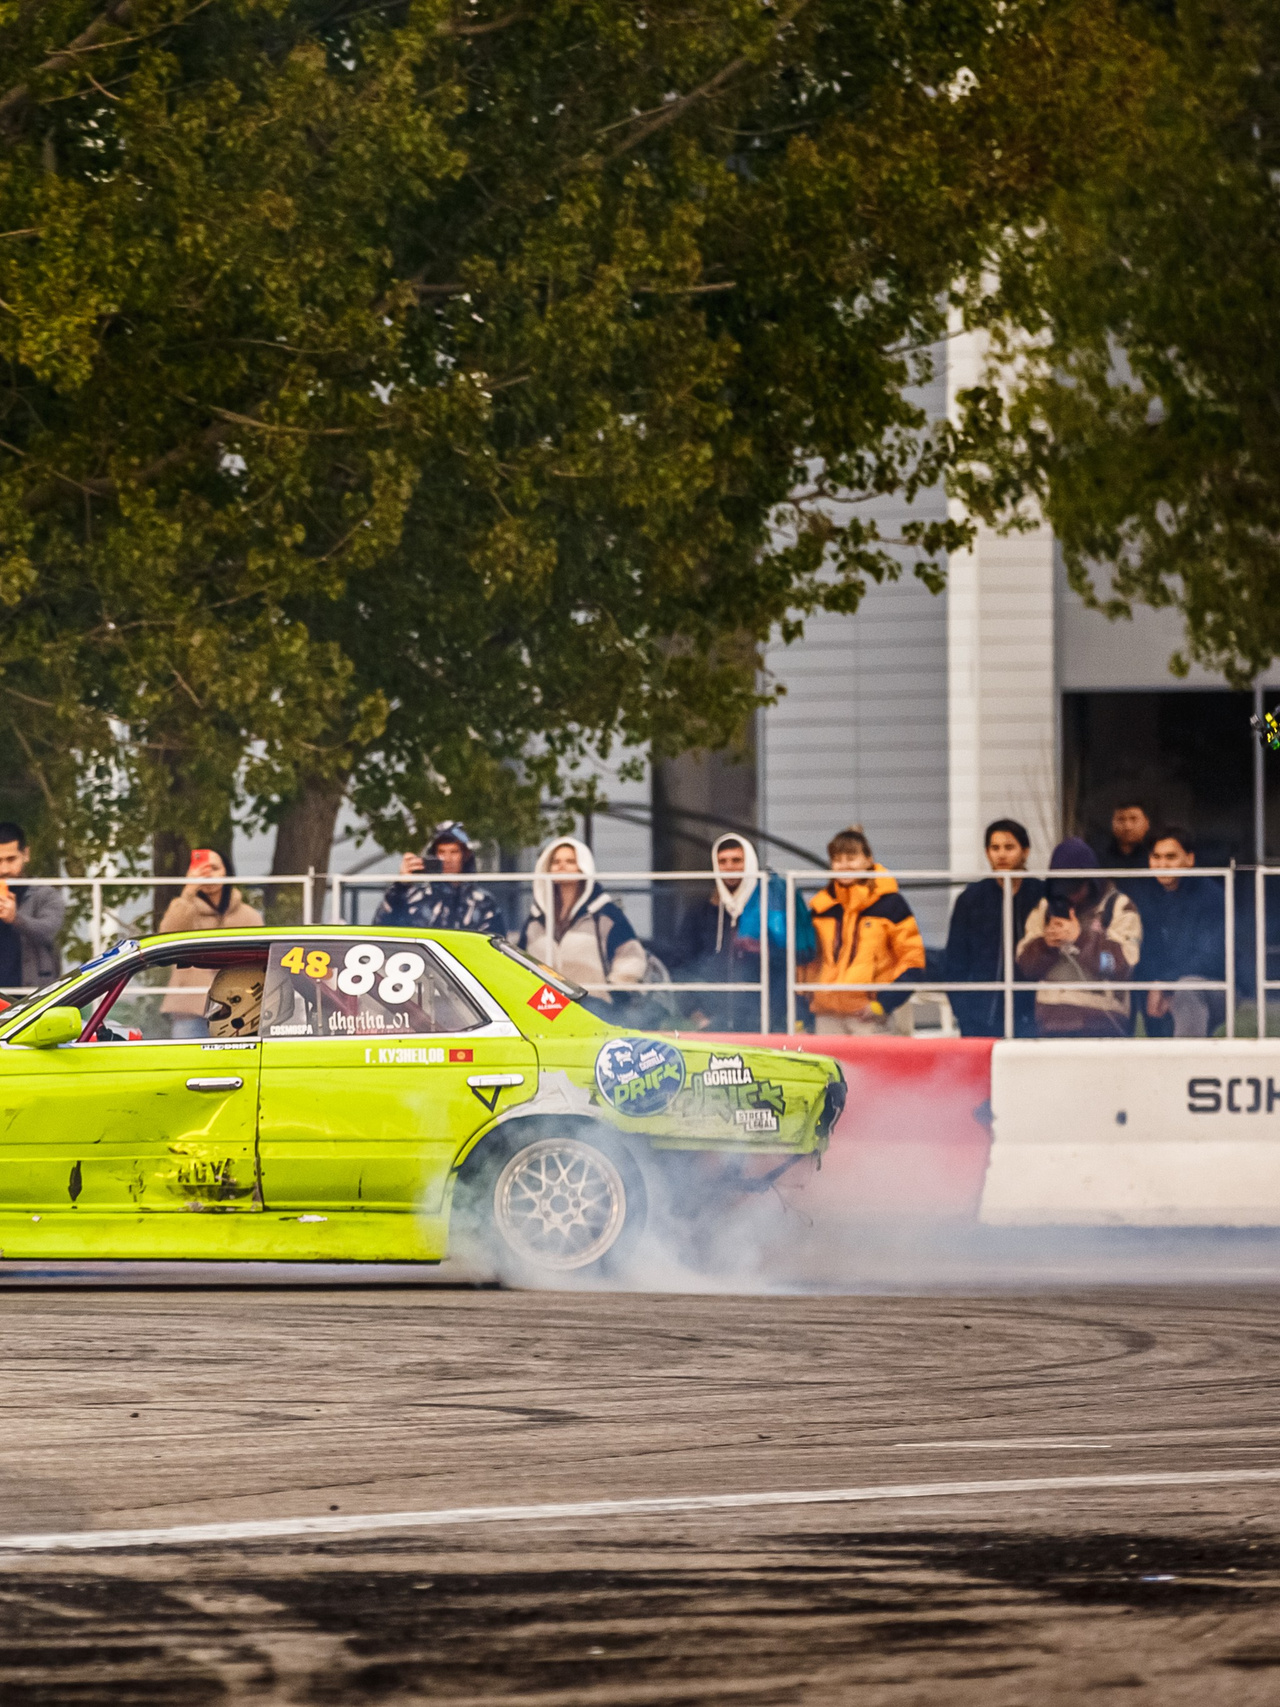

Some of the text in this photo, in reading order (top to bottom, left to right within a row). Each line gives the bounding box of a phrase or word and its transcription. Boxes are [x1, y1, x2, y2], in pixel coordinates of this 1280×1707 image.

[280, 946, 331, 979] 48
[337, 943, 425, 1005] 88
[365, 1048, 445, 1065] Г. КУЗНЕЦОВ
[703, 1068, 753, 1086] GORILLA
